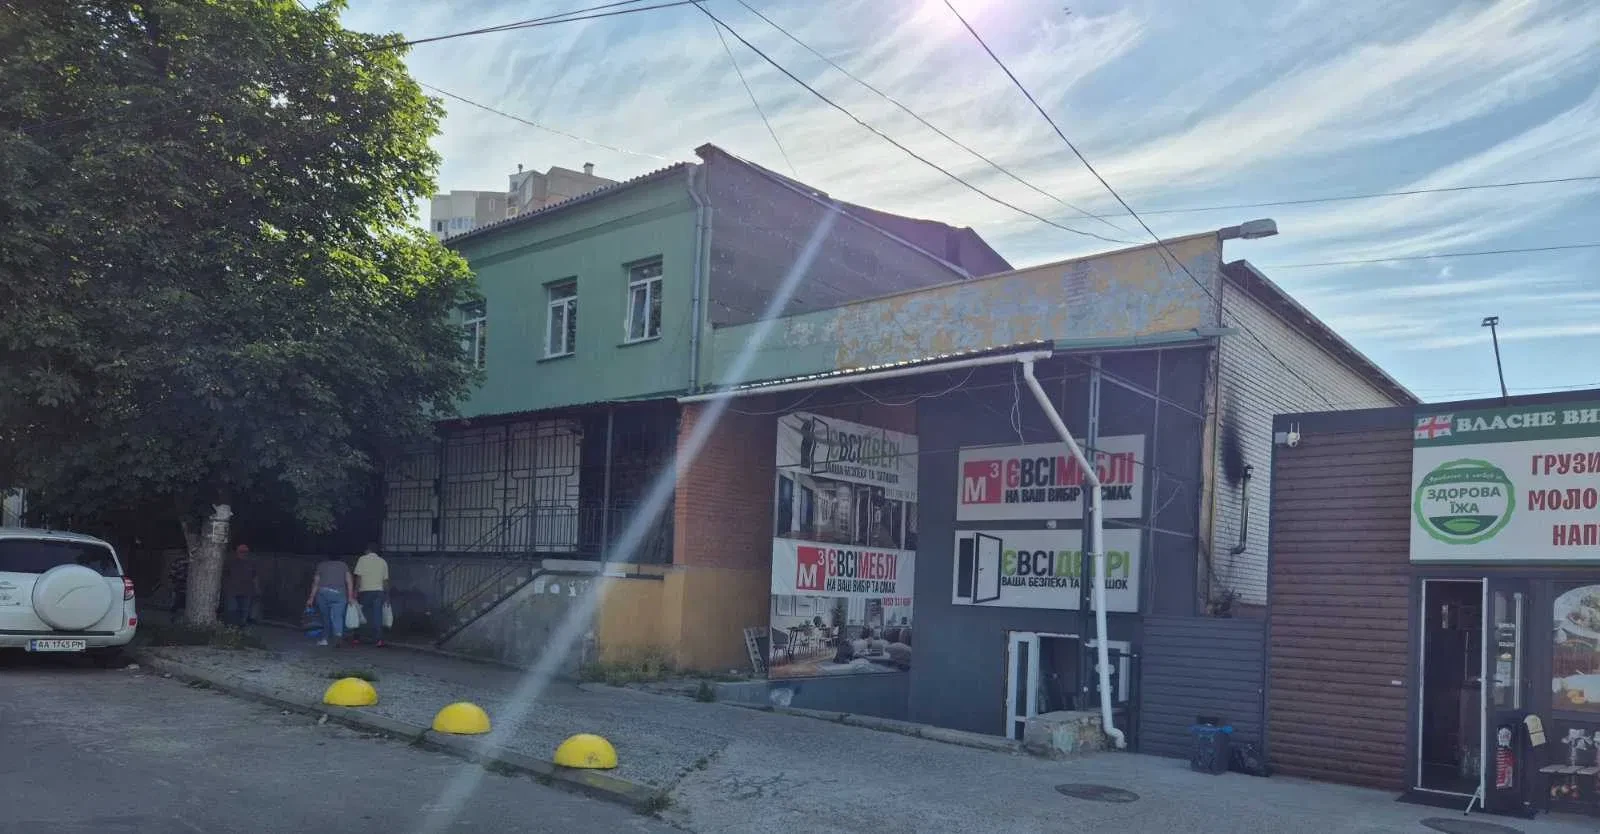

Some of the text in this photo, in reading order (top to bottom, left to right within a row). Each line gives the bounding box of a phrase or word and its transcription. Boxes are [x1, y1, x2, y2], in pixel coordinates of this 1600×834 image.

[1456, 411, 1556, 433] ВЛАСНЕ
[1005, 488, 1020, 504] НА
[1021, 487, 1046, 503] ВАШ
[1047, 486, 1081, 503] ВИБІР
[1427, 486, 1501, 502] ЗДОРОВА
[1450, 500, 1479, 514] ЇЖА
[1553, 524, 1600, 546] НАП
[827, 548, 897, 580] ЄВСІМЕБЛІ
[1002, 576, 1025, 587] ВАША
[1028, 577, 1067, 588] БЕЗПЕКА
